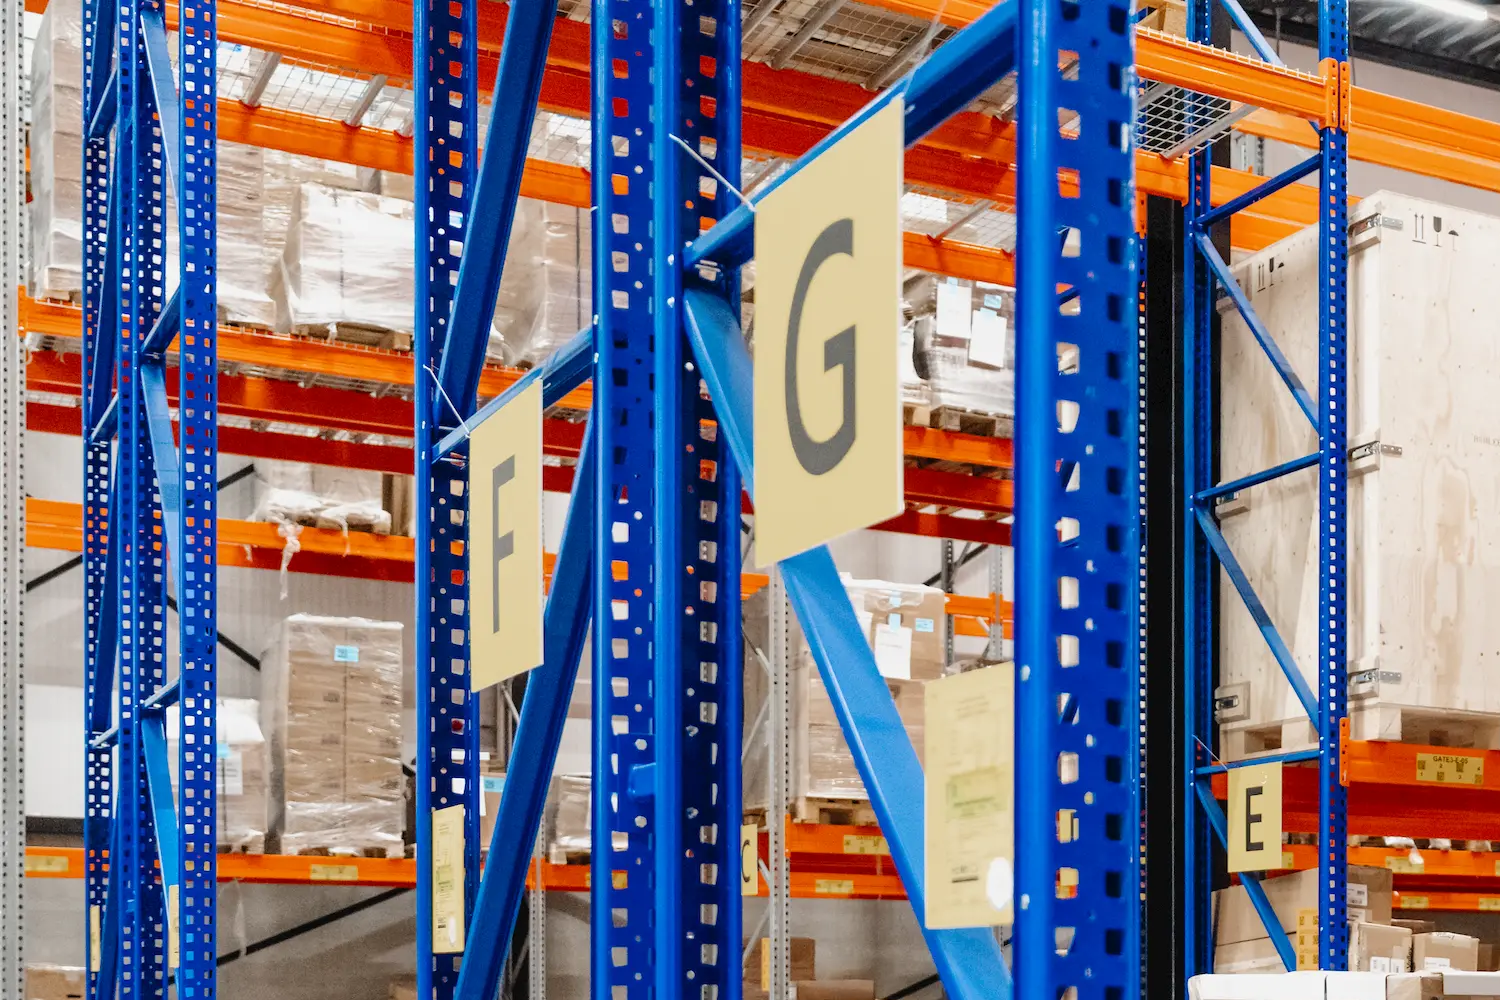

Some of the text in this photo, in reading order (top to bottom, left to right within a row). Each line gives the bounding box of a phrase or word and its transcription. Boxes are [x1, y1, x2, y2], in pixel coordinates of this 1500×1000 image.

[785, 217, 856, 476] G
[492, 454, 515, 634] F
[1246, 786, 1264, 852] E
